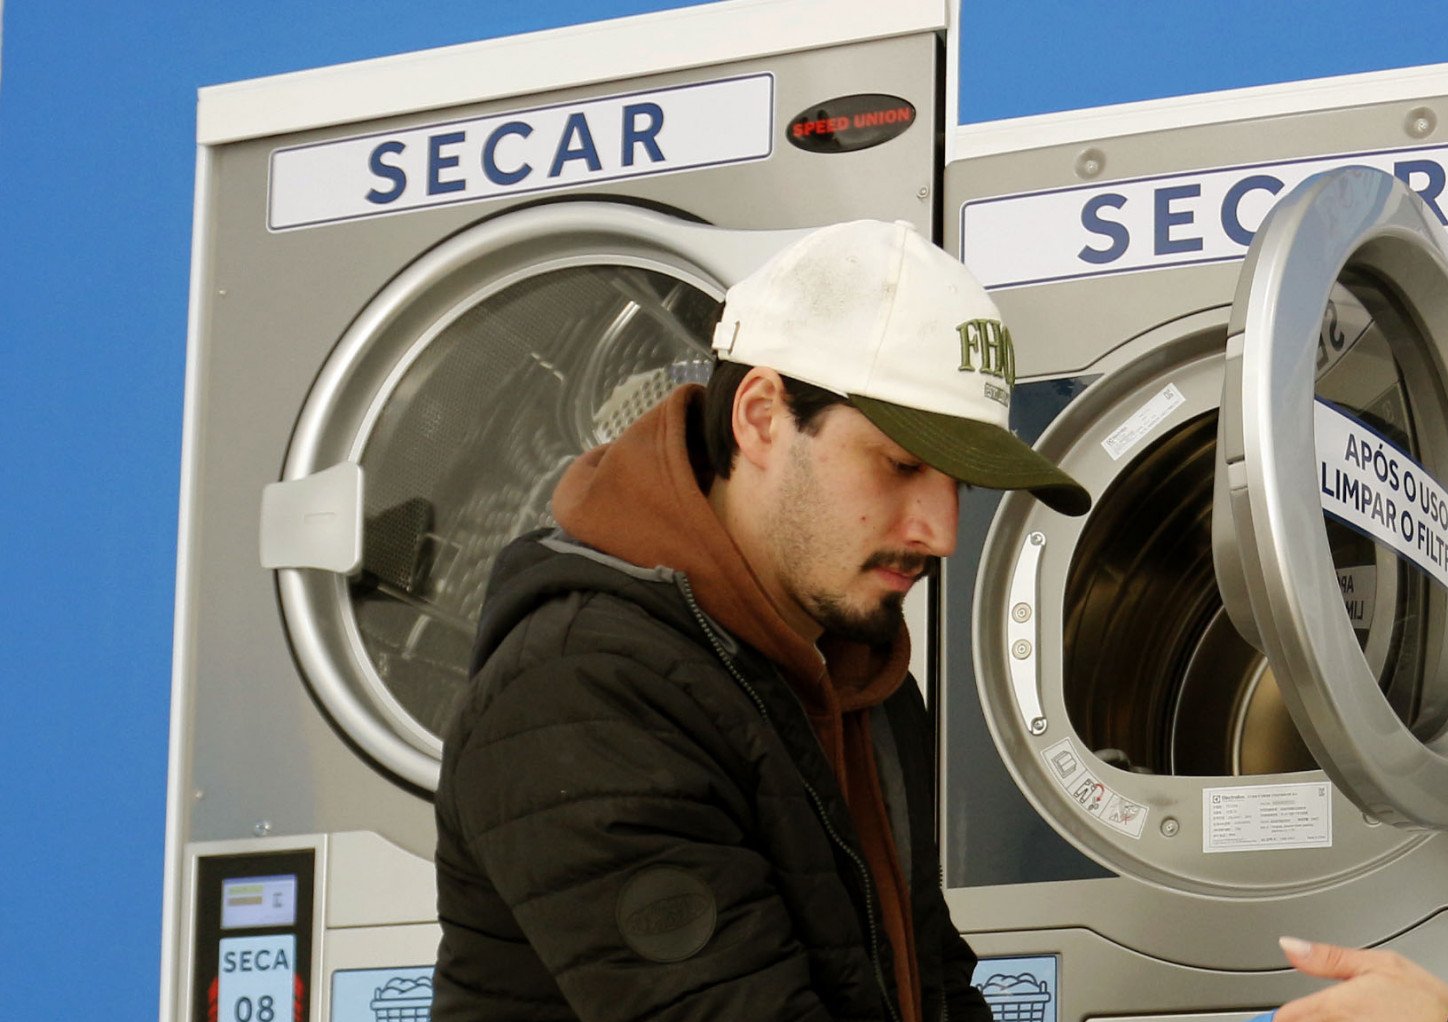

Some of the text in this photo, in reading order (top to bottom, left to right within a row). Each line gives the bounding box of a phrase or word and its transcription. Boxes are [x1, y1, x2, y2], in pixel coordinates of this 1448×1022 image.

[364, 101, 666, 204] SECAR
[792, 107, 911, 138] SPEED UNION
[1077, 158, 1448, 265] SECR
[1321, 461, 1397, 532] LIMPAR
[1401, 510, 1414, 543] O
[1345, 433, 1448, 531] APÓS O USO
[223, 948, 289, 972] SECA
